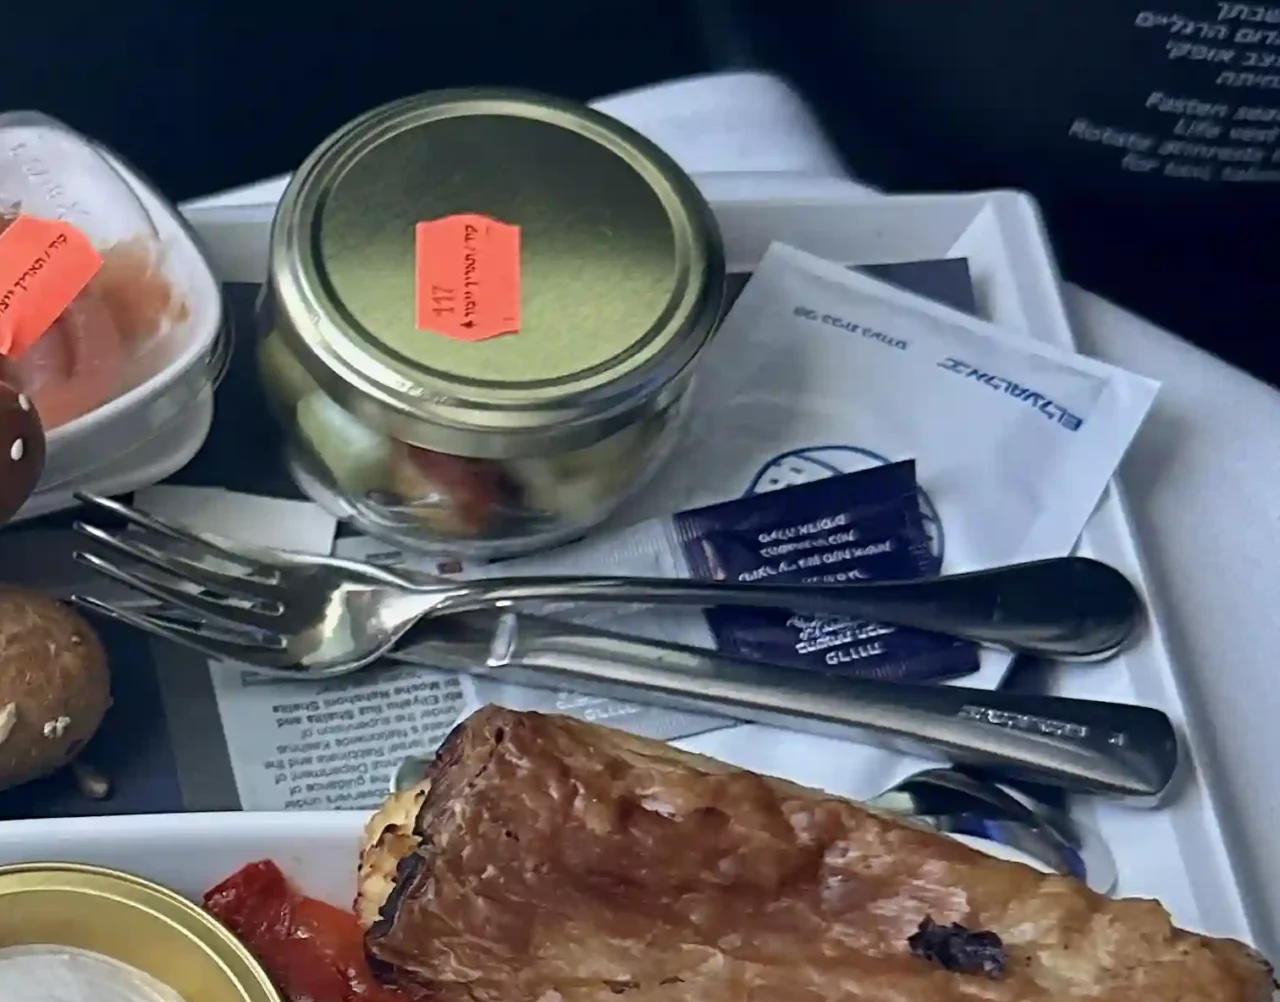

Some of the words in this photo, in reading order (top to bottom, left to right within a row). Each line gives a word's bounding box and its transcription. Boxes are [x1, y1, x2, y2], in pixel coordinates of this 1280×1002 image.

[14, 257, 46, 291] תאריך
[825, 642, 885, 664] פרווה
[317, 716, 390, 736] supervision
[291, 762, 368, 781] Department
[305, 776, 365, 793] guidance
